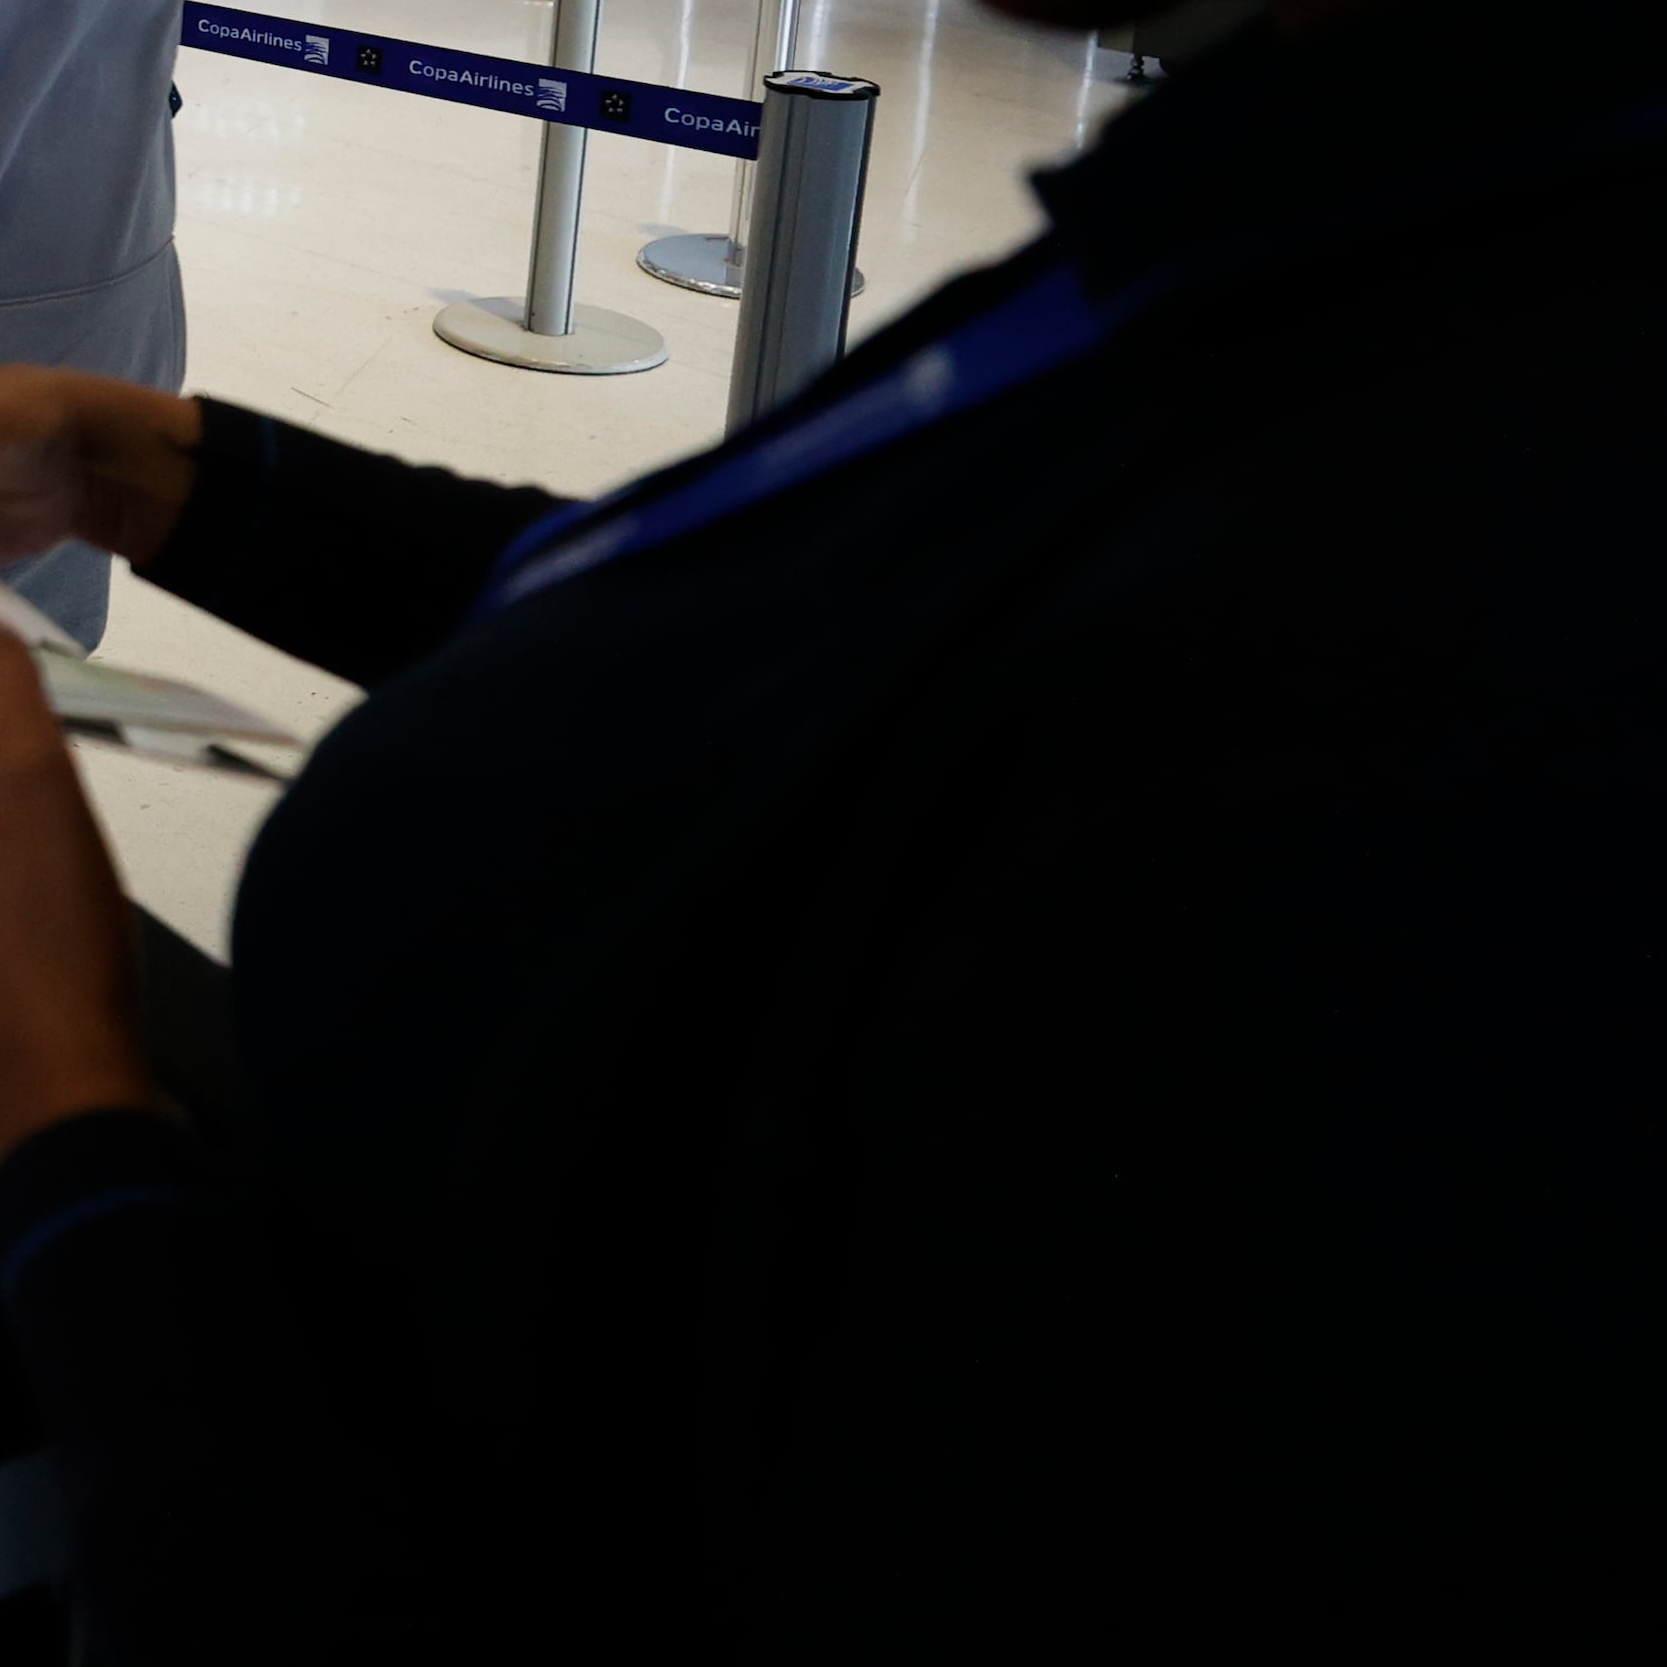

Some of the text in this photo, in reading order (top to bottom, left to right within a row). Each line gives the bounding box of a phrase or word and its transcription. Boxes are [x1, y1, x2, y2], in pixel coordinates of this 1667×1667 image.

[197, 19, 302, 52] CopaAirlines
[409, 59, 534, 96] CopaAirlines
[664, 107, 760, 139] CopaAir
